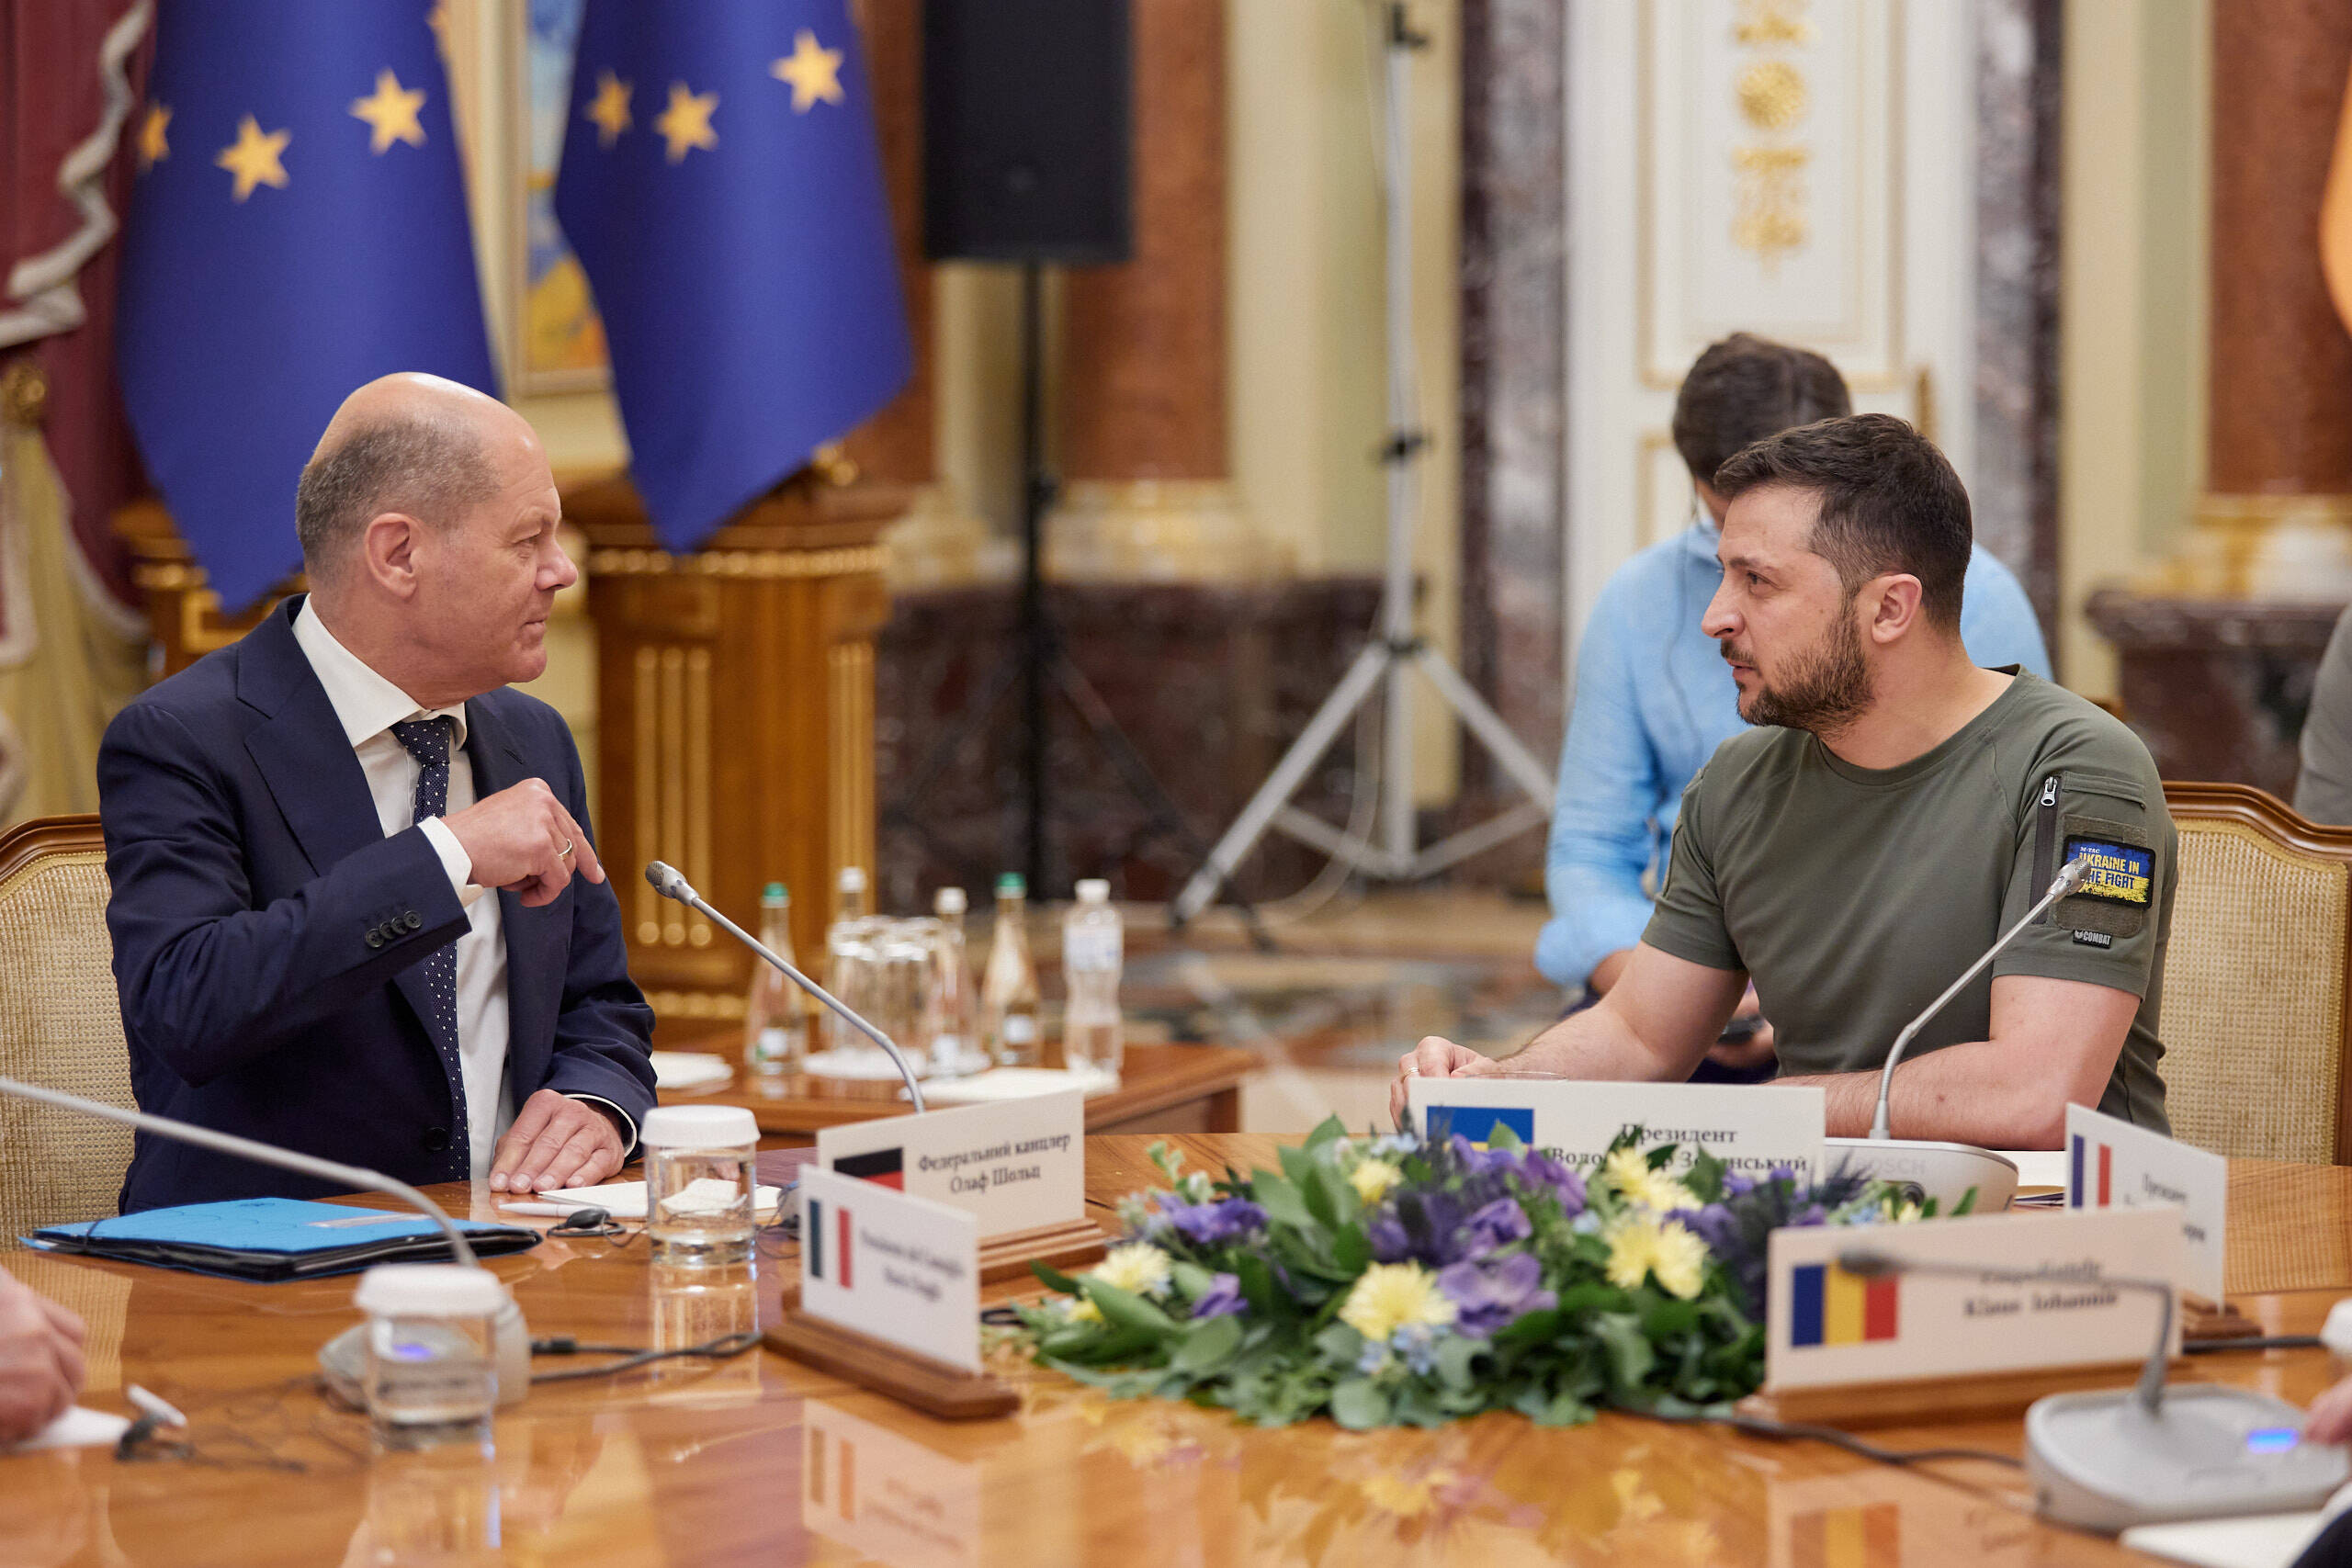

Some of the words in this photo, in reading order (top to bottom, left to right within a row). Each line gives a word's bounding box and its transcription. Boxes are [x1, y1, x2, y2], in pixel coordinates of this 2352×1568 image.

[2128, 861, 2140, 875] IN
[2086, 870, 2102, 885] HE
[2104, 873, 2135, 890] FIGHT
[2083, 931, 2111, 945] COMBAT
[1622, 1123, 1738, 1145] Президент
[917, 1141, 1012, 1172] Федеральний
[1014, 1134, 1071, 1155] канцлер
[950, 1171, 989, 1194] Олаф
[992, 1165, 1042, 1187] Шольц
